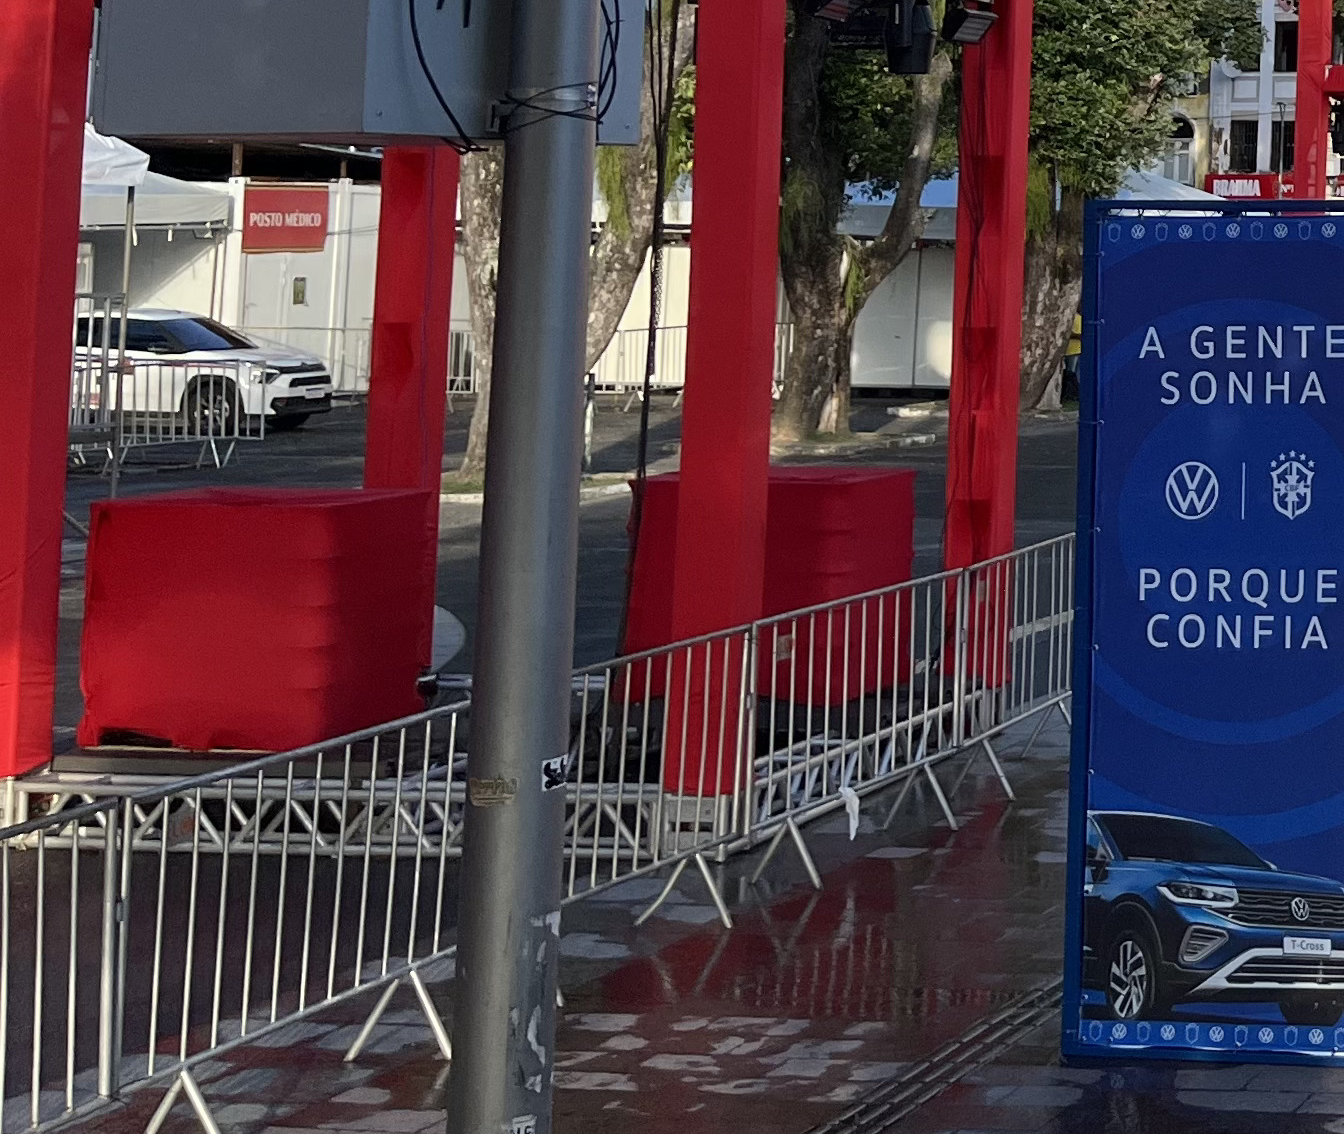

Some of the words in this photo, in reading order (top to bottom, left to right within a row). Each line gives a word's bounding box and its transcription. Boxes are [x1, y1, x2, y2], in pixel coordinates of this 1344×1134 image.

[249, 212, 283, 228] POSTO
[284, 209, 322, 227] MÉDICO
[1139, 326, 1165, 359] A
[1160, 370, 1327, 405] SONHA
[1139, 568, 1338, 607] PORQUE
[1146, 614, 1328, 650] CONFIA
[1289, 939, 1325, 952] T-Cross
